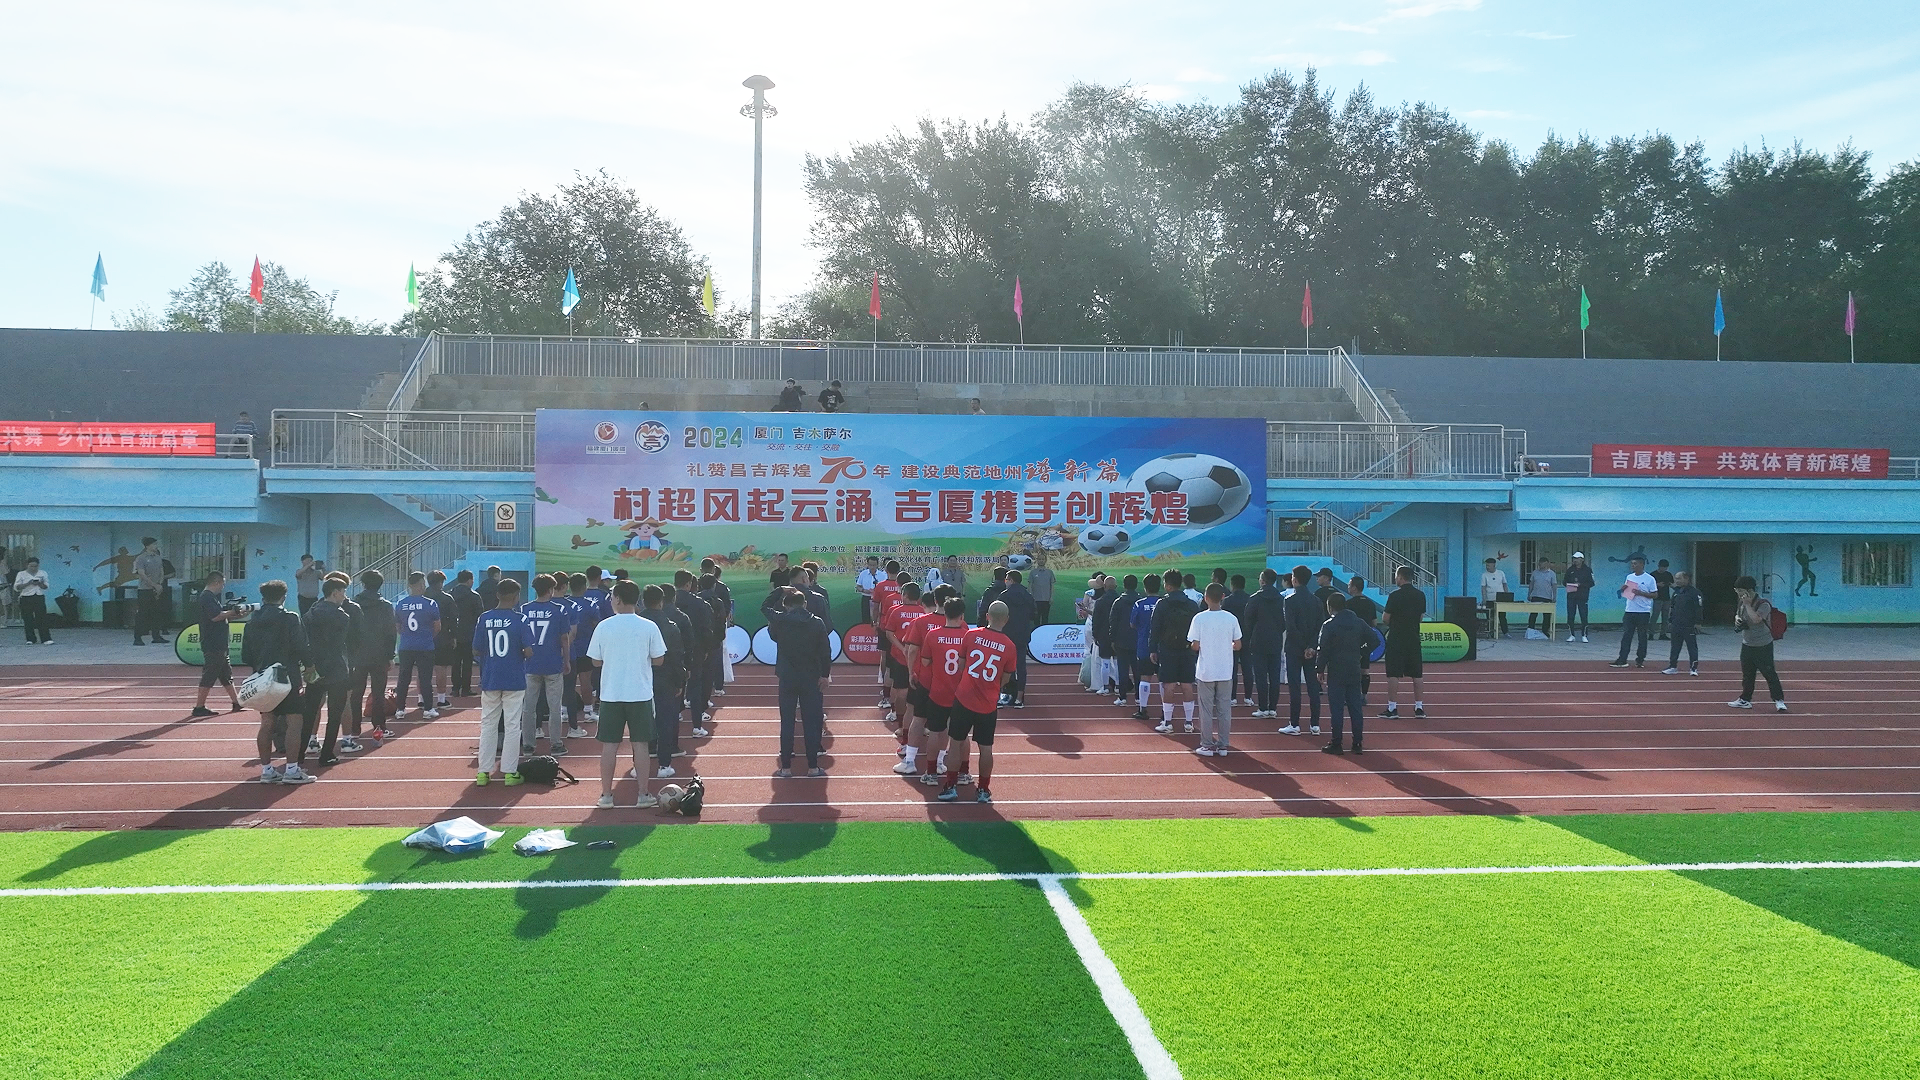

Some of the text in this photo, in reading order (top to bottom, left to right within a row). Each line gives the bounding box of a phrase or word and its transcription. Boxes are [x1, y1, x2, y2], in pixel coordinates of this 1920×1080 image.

[3, 426, 199, 450] 共舞 乡村体育新篇章
[684, 426, 852, 448] 2024 厦门 吉木萨尔
[1611, 449, 1872, 473] 吉厦携手 共筑体育新辉煌
[613, 487, 1189, 525] 村超风起云涌 吉厦携手创辉煌
[407, 611, 419, 632] 6
[485, 618, 511, 628] 新地乡
[528, 610, 552, 619] 新地乡
[487, 629, 510, 658] 10
[944, 649, 959, 676] 8
[968, 649, 1001, 682] 25
